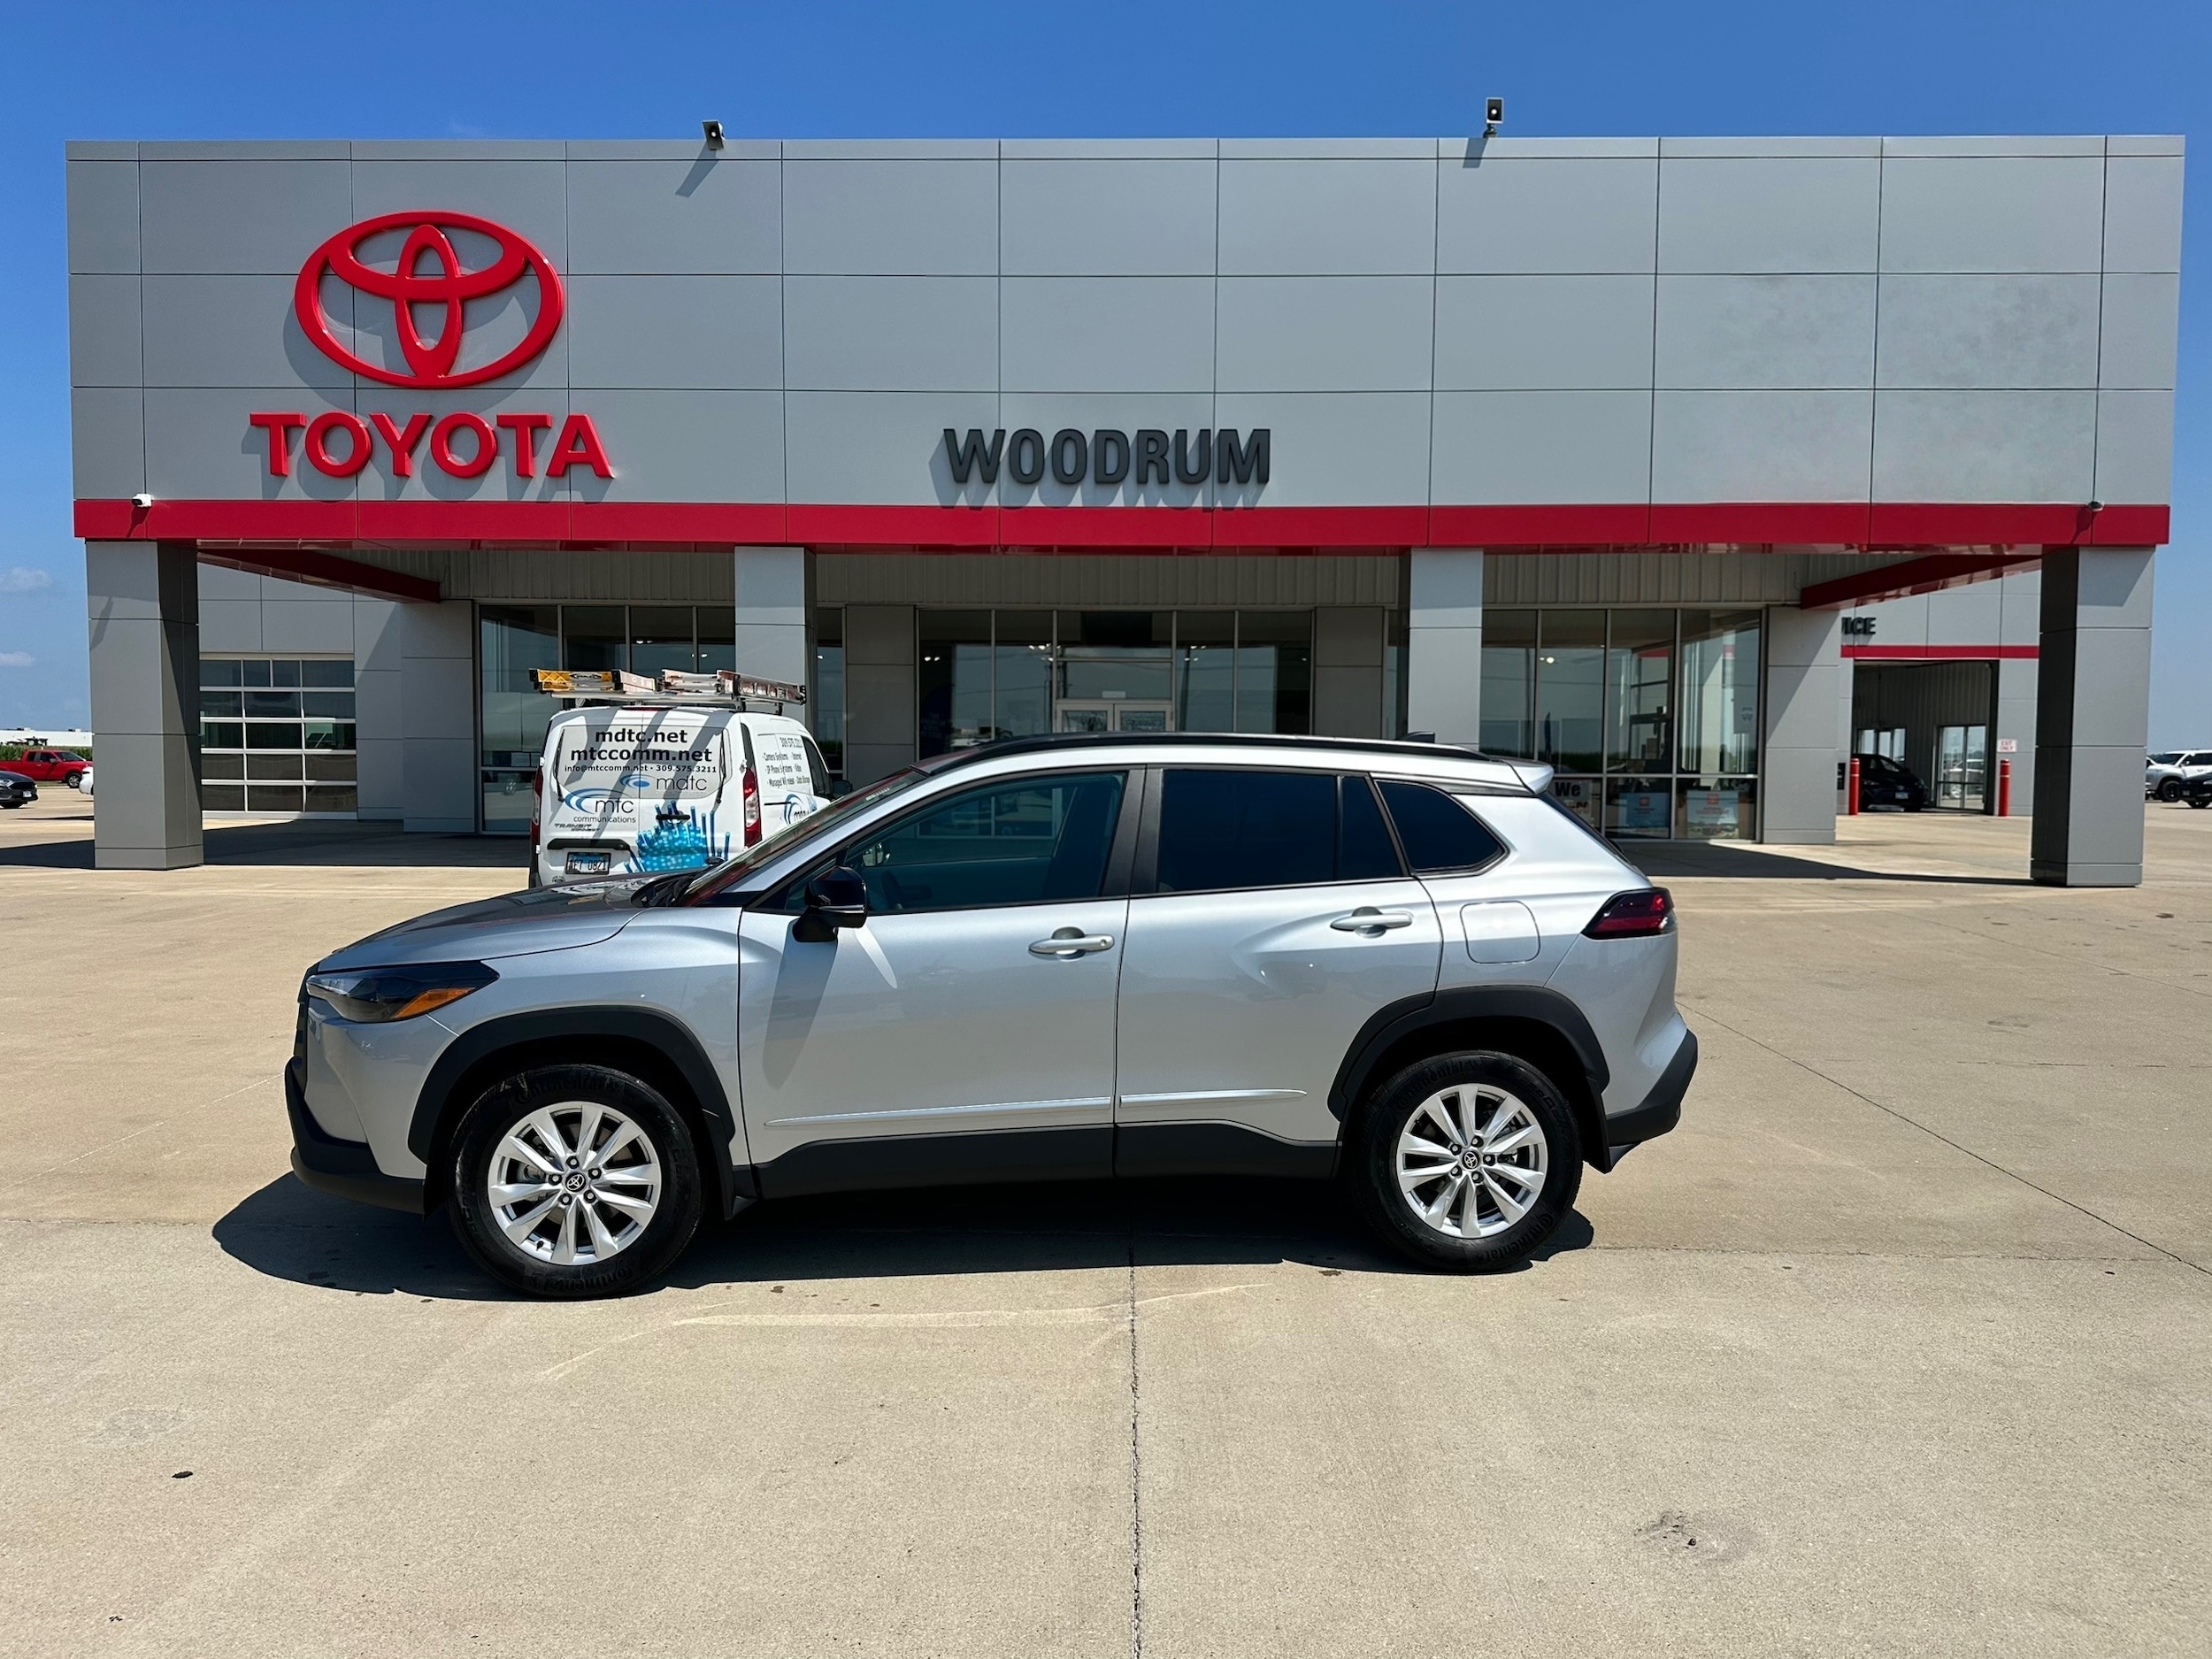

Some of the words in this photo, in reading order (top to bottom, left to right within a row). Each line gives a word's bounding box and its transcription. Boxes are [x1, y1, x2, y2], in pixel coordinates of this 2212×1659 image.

[250, 411, 615, 479] TOYOTA
[943, 427, 1271, 484] WOODRUM
[595, 728, 688, 743] mdtc.net
[571, 747, 712, 762] mtccomm.net
[657, 775, 707, 790] mdtc
[1555, 782, 1581, 796] We
[595, 797, 634, 814] mtc
